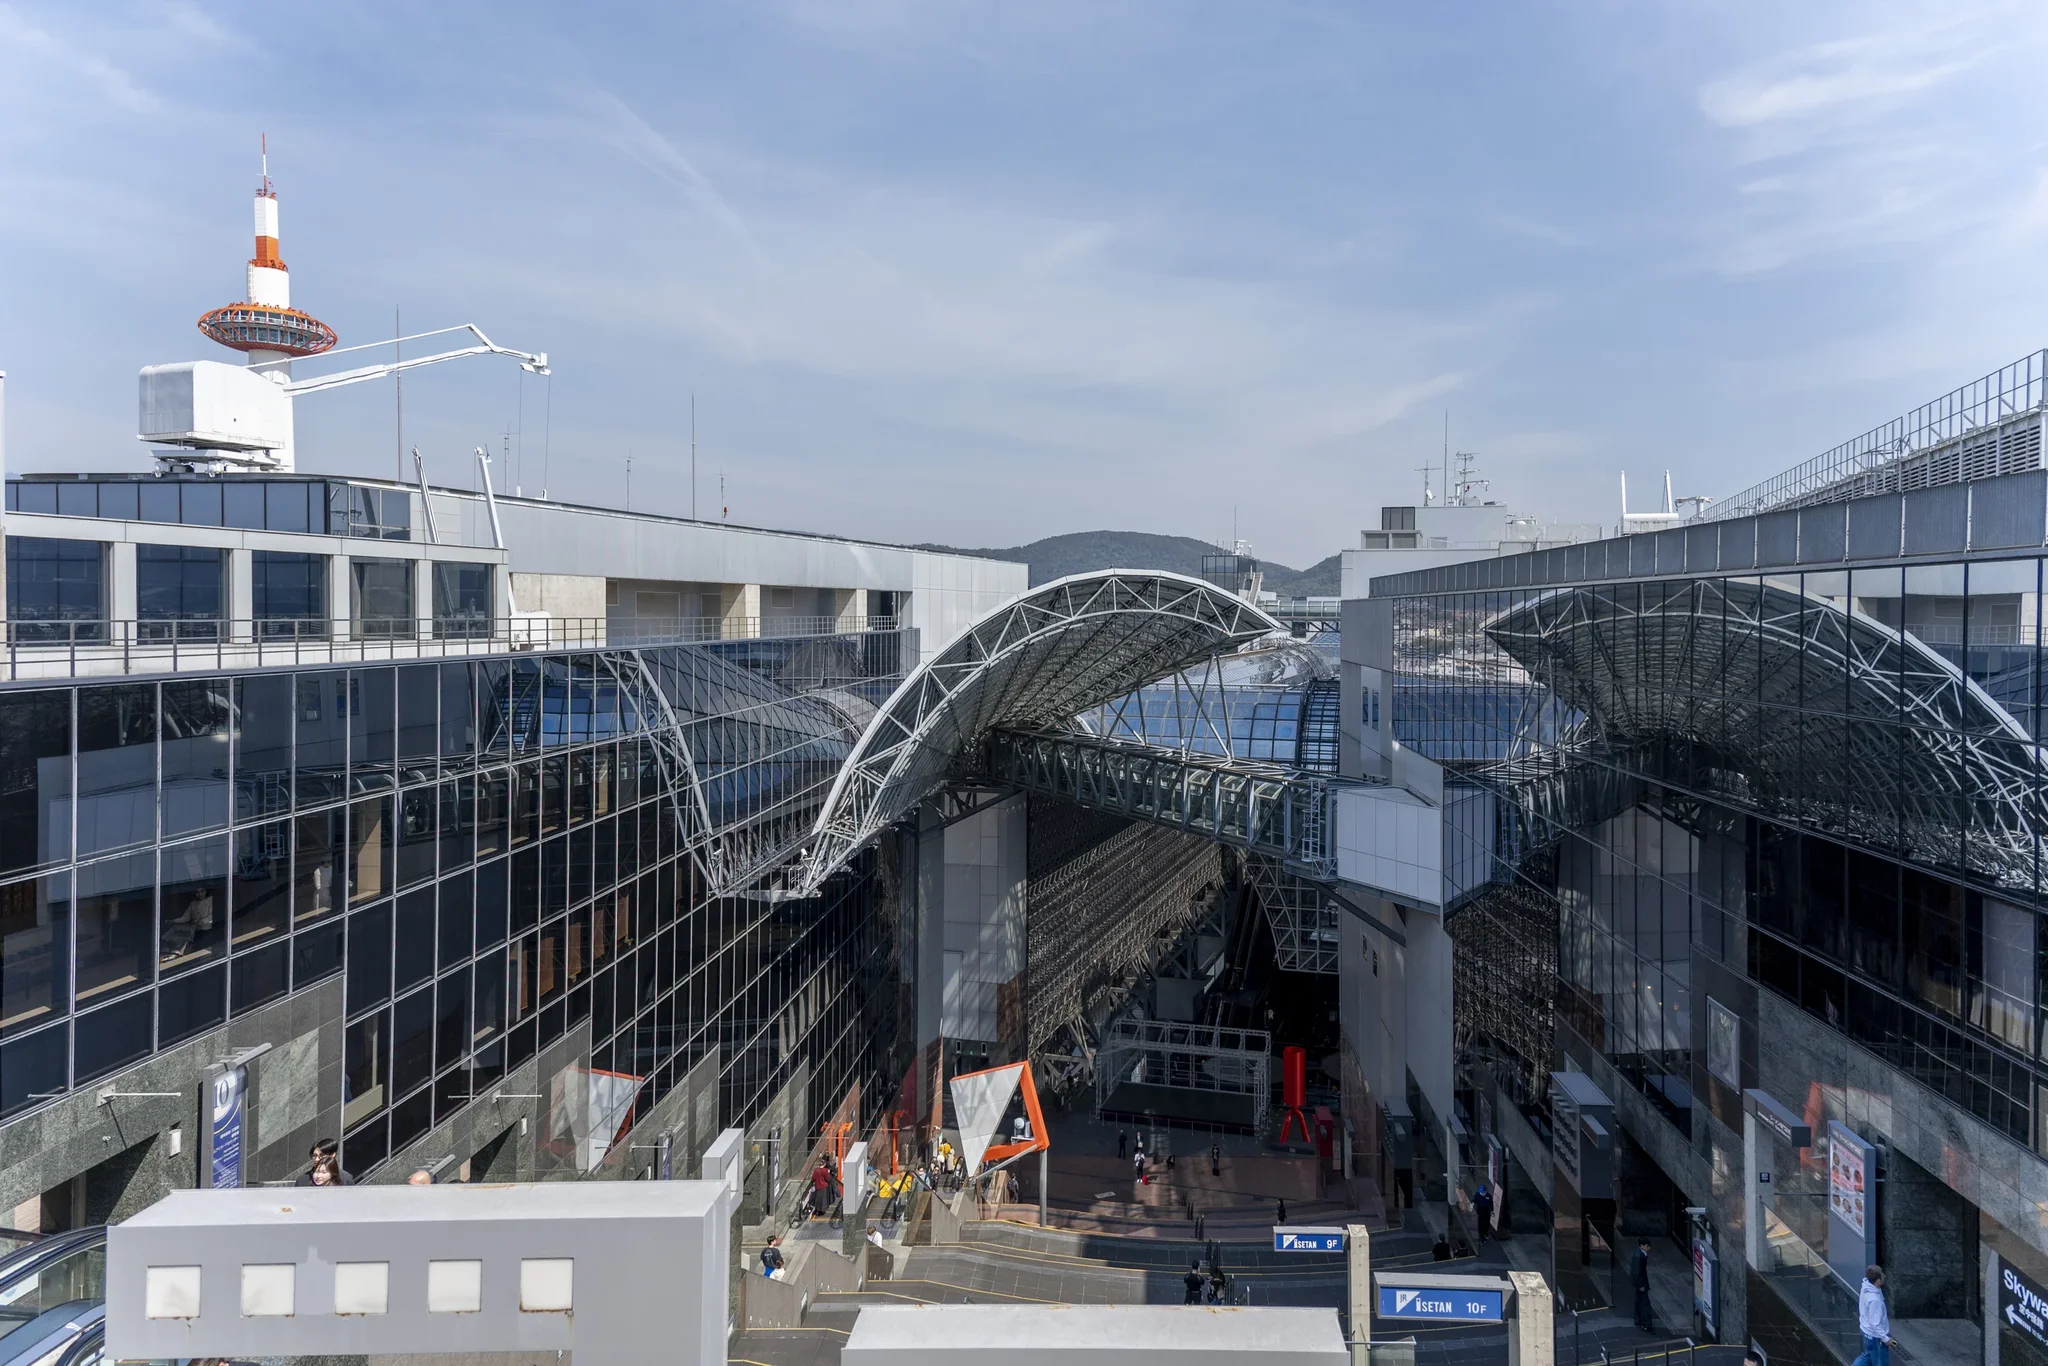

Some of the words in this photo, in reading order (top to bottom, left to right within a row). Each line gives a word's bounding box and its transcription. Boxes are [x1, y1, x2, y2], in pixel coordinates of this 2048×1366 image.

[1326, 1239, 1338, 1249] 9F
[1400, 1293, 1407, 1303] JR
[1466, 1302, 1487, 1314] 10F
